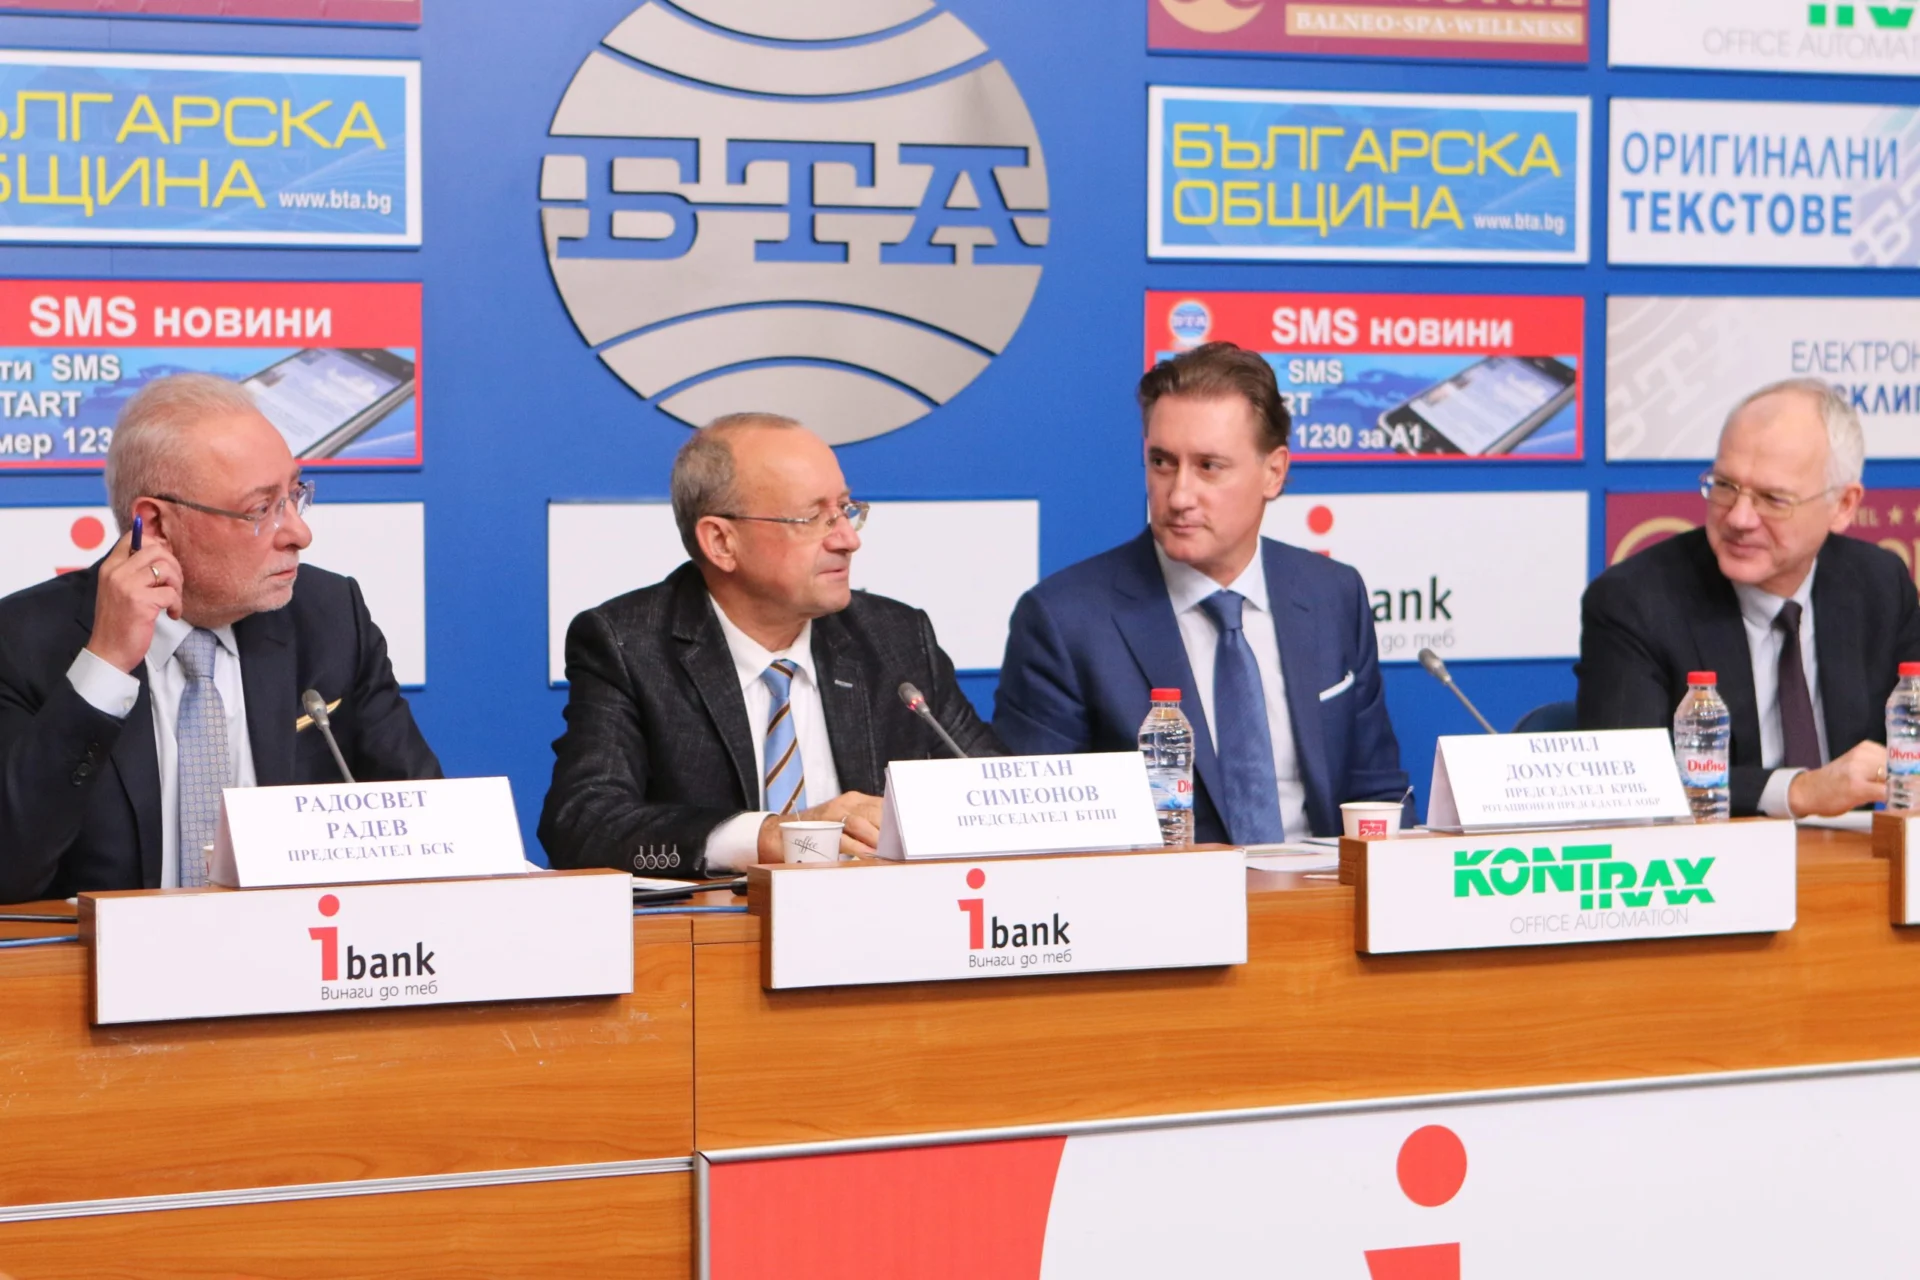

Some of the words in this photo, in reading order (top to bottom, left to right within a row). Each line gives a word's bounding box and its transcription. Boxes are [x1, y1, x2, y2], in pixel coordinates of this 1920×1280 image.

[1702, 28, 1791, 57] OFFICE
[1173, 122, 1562, 178] БЪЛГАРСКА
[1621, 131, 1898, 180] ОРИГИНАЛНИ
[279, 188, 392, 215] www.bta.bg
[556, 135, 1030, 264] БТА
[1173, 180, 1465, 238] ОБЩИНА
[1621, 189, 1853, 237] ТЕКСТОВЕ
[1473, 212, 1567, 236] www.bta.bg
[29, 295, 138, 338] SMS
[153, 307, 332, 338] новини
[1271, 307, 1359, 347] SMS
[1370, 318, 1514, 348] новини
[51, 353, 120, 382] SMS
[1288, 358, 1345, 385] SMS
[1295, 422, 1353, 449] 1230
[1358, 429, 1387, 449] за
[1372, 574, 1453, 623] ank
[1528, 736, 1601, 756] КИРИЛ
[981, 759, 1074, 781] ЦВЕТАН
[1506, 760, 1637, 783] ДОМУСЧИЕВ
[295, 790, 428, 814] РАДОСВЕТ
[966, 785, 1100, 808] СИМЕОНОВ
[1504, 784, 1605, 801] ПРЕДСЕДАТЕЛ
[1611, 781, 1649, 796] КРИБ
[957, 810, 1069, 828] ПРЕДСЕДАТЕЛ
[1076, 808, 1118, 823] БТПП
[1557, 798, 1633, 812] ПРЕДСЕДАТЕЛ
[326, 818, 409, 841] РАДЕВ
[288, 843, 413, 863] ПРЕДСЕДАТЕЛ
[421, 841, 456, 857] БСК
[1454, 843, 1716, 911] KONTRAX
[1509, 913, 1570, 935] OFFICE
[1573, 907, 1690, 932] AUTOMATION
[968, 954, 1016, 969] Винаги
[1020, 953, 1038, 969] до
[1043, 948, 1073, 965] теб
[320, 986, 374, 1001] Винаги
[379, 985, 400, 1002] до
[405, 979, 439, 997] теб
